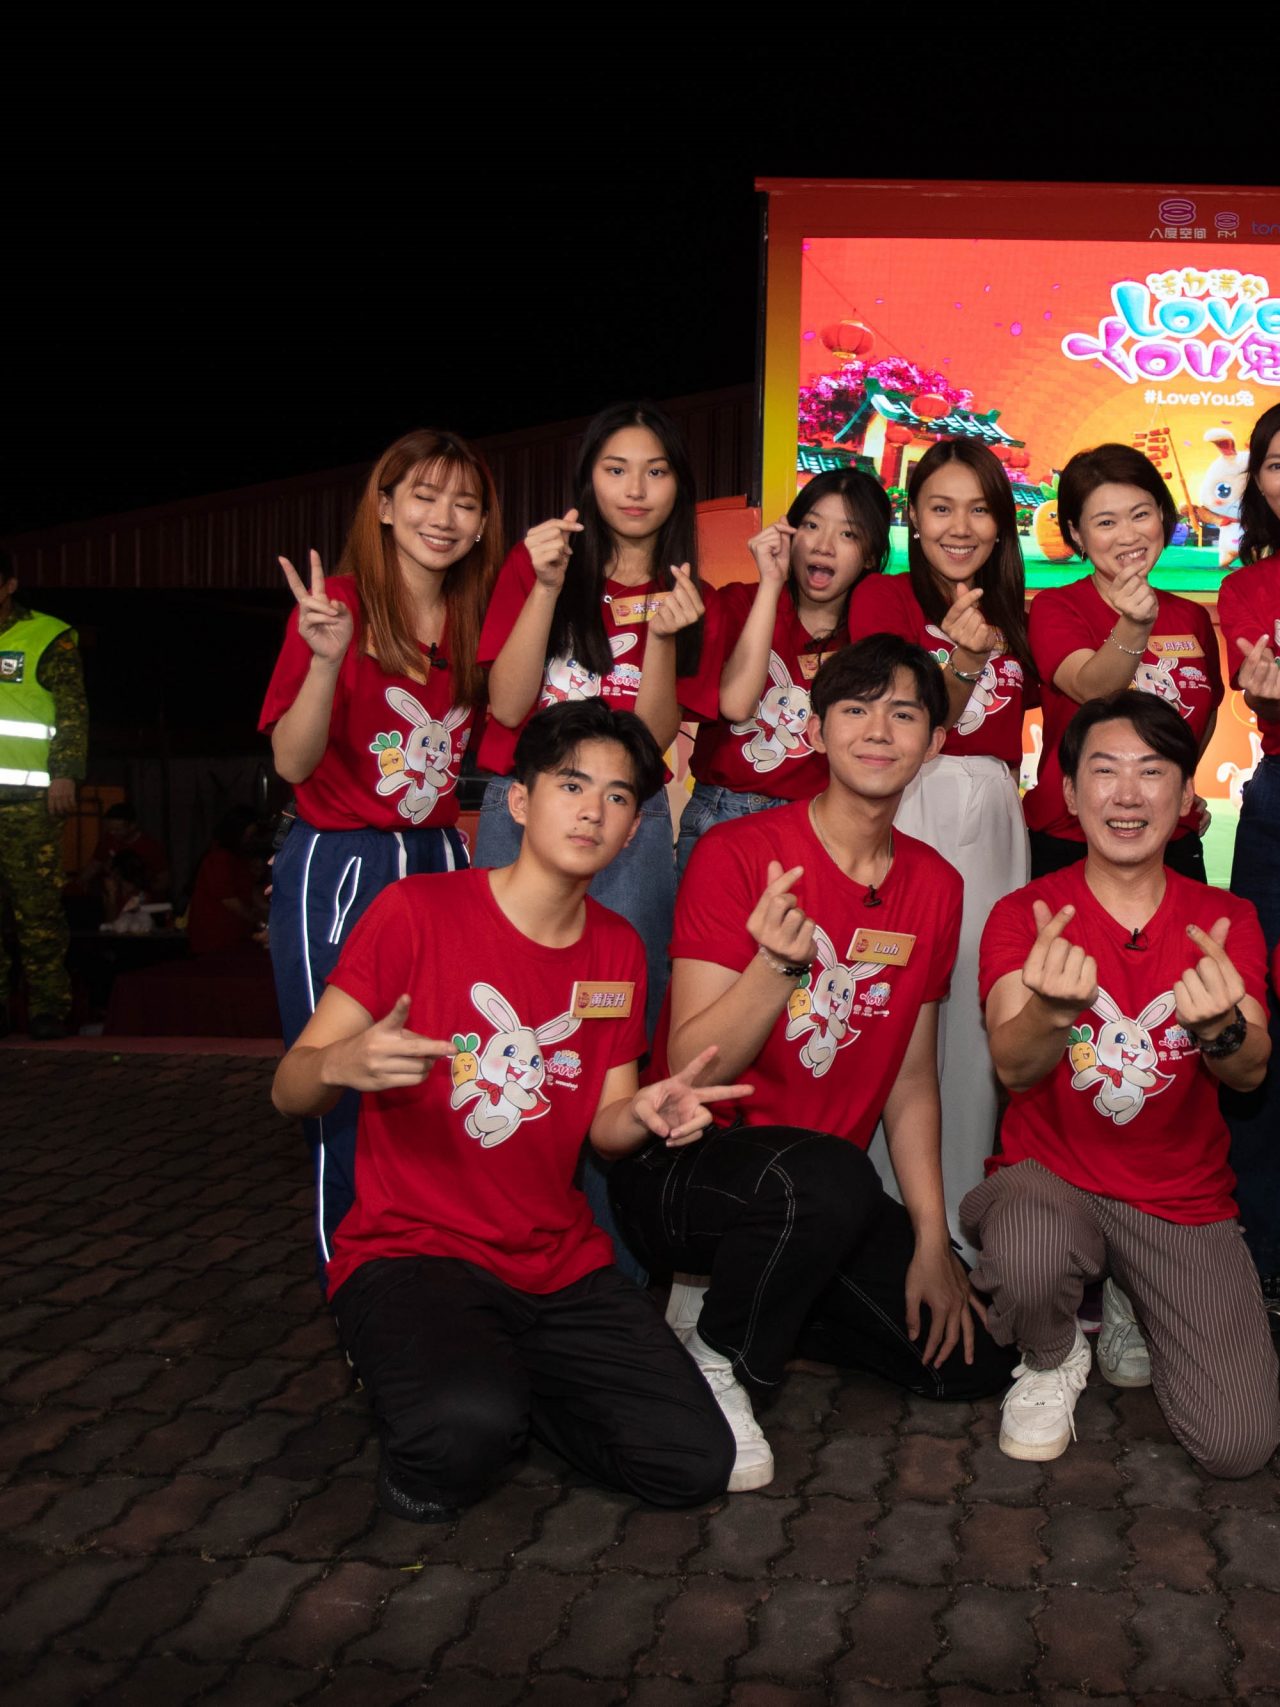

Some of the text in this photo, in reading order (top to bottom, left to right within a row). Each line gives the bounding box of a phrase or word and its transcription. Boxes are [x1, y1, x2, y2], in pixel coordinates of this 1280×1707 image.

[1149, 227, 1207, 240] 八度空间
[1217, 230, 1238, 239] FM
